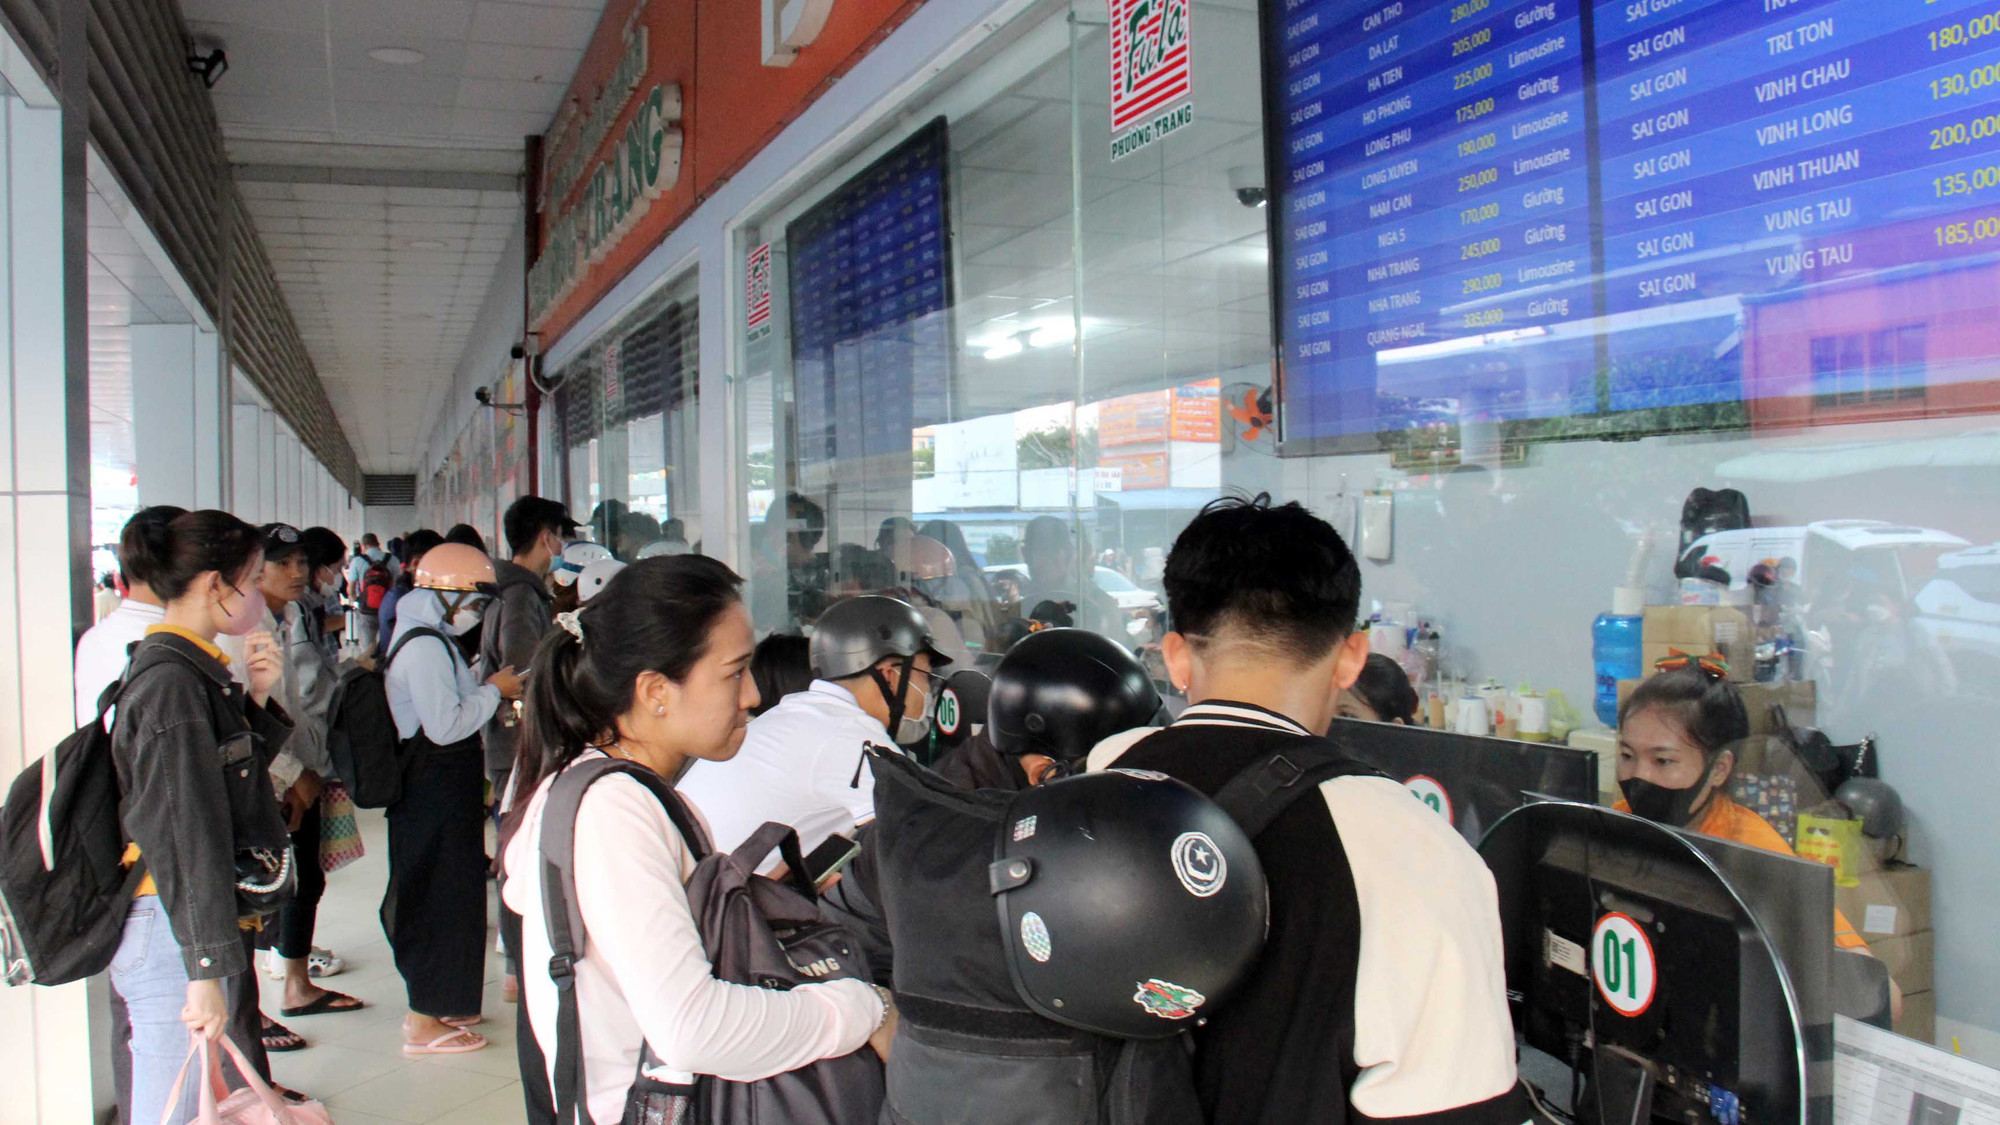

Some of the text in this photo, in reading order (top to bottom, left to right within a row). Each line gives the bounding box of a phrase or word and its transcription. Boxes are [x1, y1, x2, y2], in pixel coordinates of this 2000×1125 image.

[1288, 2, 1402, 68] SAI GON CAN THO
[1300, 13, 1318, 32] GON
[1626, 0, 1648, 22] SAI
[1628, 26, 1685, 61] SAI GON
[1290, 82, 1300, 97] SAI
[1302, 72, 1320, 91] GON
[1369, 44, 1382, 60] DA
[1382, 34, 1399, 53] LAT
[1290, 110, 1302, 125] SAI
[1304, 101, 1322, 119] GON
[1368, 76, 1381, 92] HA
[1382, 66, 1403, 86] TIEN
[1452, 28, 1491, 56] 205,000
[1630, 18, 1834, 100] SAI GON TRI TON
[1155, 104, 1191, 138] TRANG
[1292, 37, 1565, 154] SAI GON HO PHONG 225,000 Limousine
[1632, 119, 1654, 140] SAI
[1656, 108, 1688, 132] GON
[1754, 74, 1797, 102] VINH
[1801, 58, 1851, 90] CHAU
[1293, 167, 1305, 183] SAI
[1306, 160, 1324, 178] GON
[1366, 136, 1390, 156] LONG
[1392, 127, 1412, 147] PHU
[1456, 97, 1494, 122] 175,000
[1294, 111, 1568, 212] SAI GON LONG XUYEN 190,000 Limousine
[1634, 158, 1656, 180] SAI
[1658, 149, 1690, 172] GON
[1756, 118, 1798, 146] VINH
[1802, 104, 1853, 135] LONG
[1295, 148, 1570, 241] SAI GON NAM CAN 250,000 Limousine
[1636, 198, 1658, 219] SAI
[1660, 190, 1692, 212] GON
[1753, 165, 1794, 191] VINH
[1798, 149, 1860, 180] THUAN
[1637, 165, 2000, 258] SAI GON VUNG TAU 135,00
[1296, 254, 1308, 270] SAI
[1310, 250, 1328, 267] GON
[1378, 231, 1398, 248] NGA
[1399, 228, 1406, 242] 5
[1460, 203, 1499, 226] 170,000
[1297, 284, 1309, 299] SAI
[1310, 280, 1329, 296] GON
[1368, 266, 1388, 282] NHA
[1389, 258, 1420, 276] TRANG
[1462, 238, 1500, 260] 245,000
[1638, 216, 2000, 298] SAI GON VUNG TAU 185,00
[1298, 260, 1575, 328] SAI GON NHA TRANG 290,000 Limousine
[1300, 344, 1312, 358] SAI
[1312, 340, 1331, 355] GON
[1464, 308, 1504, 328] 335,000
[939, 697, 955, 726] 06
[1604, 929, 1637, 1000] 01
